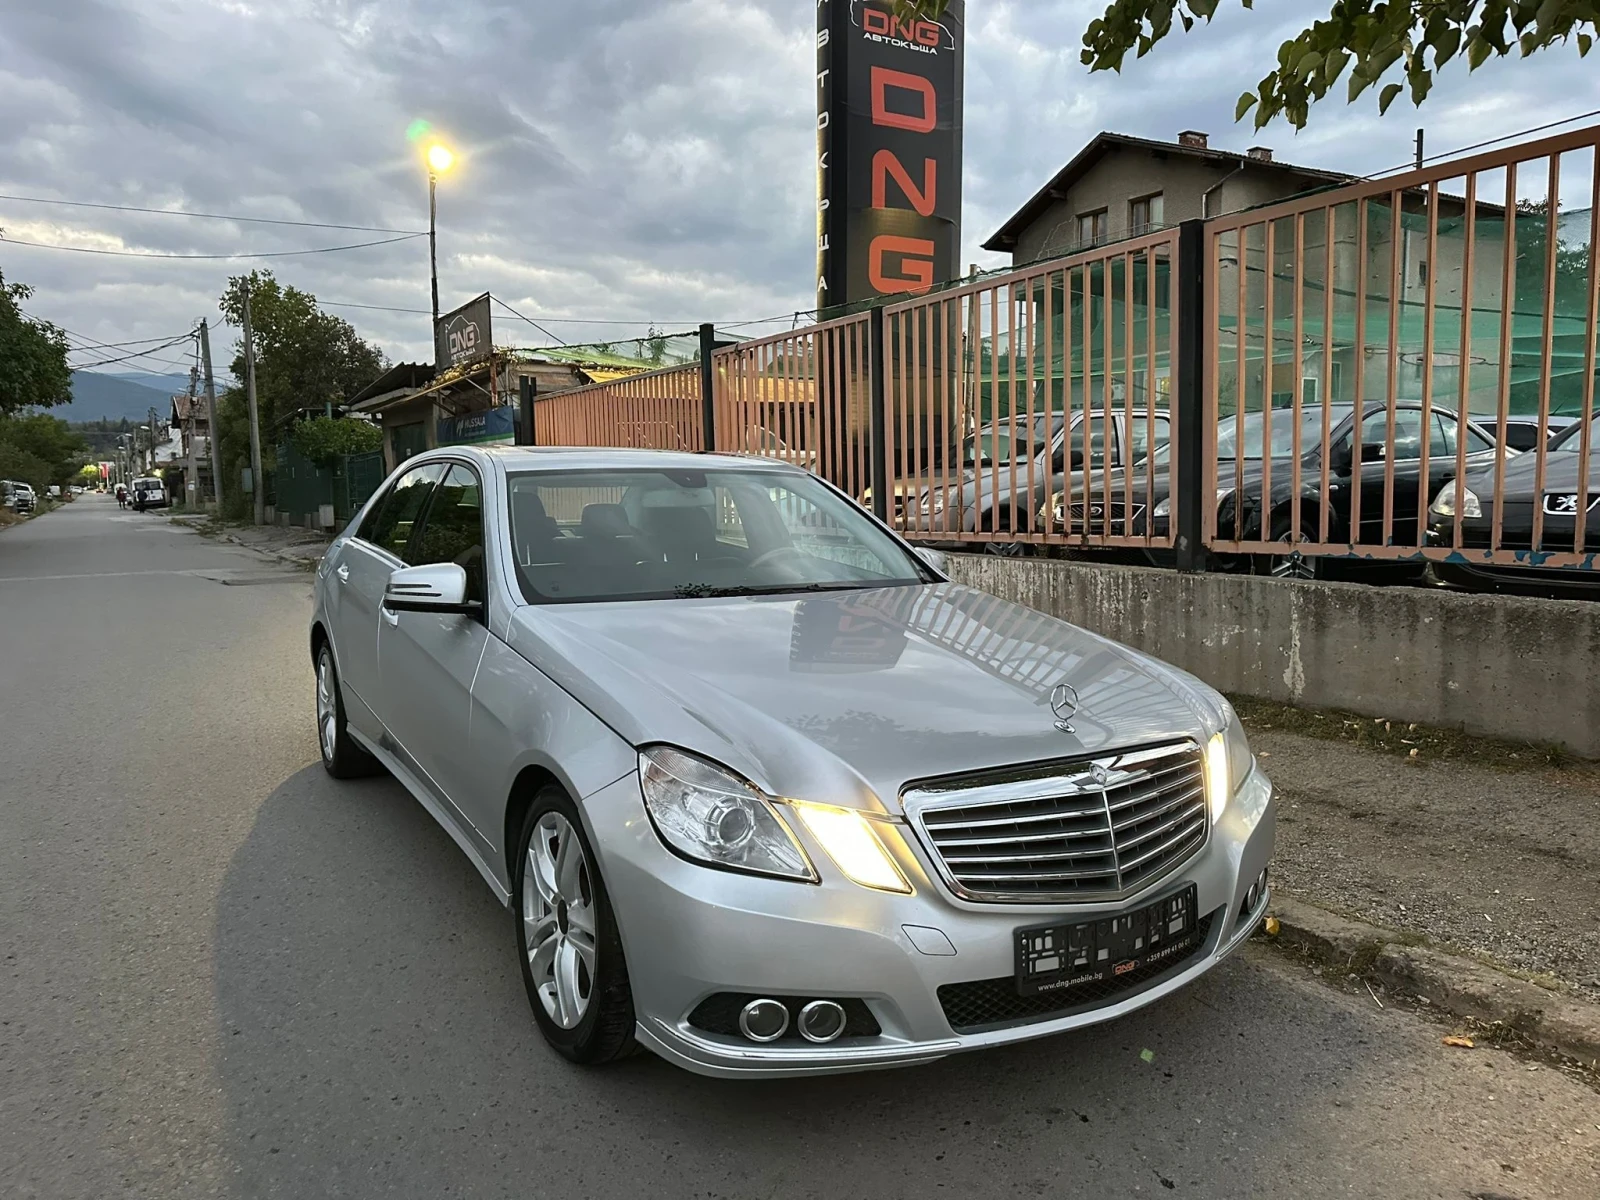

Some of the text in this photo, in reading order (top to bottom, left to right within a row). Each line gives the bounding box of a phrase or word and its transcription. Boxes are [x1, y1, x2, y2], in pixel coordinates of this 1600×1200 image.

[863, 8, 940, 47] DNG
[869, 65, 937, 294] DNG
[449, 324, 475, 354] DNG
[1146, 952, 1161, 962] +359
[1171, 944, 1178, 952] 41
[1037, 972, 1103, 991] www.dng.mobile.bg
